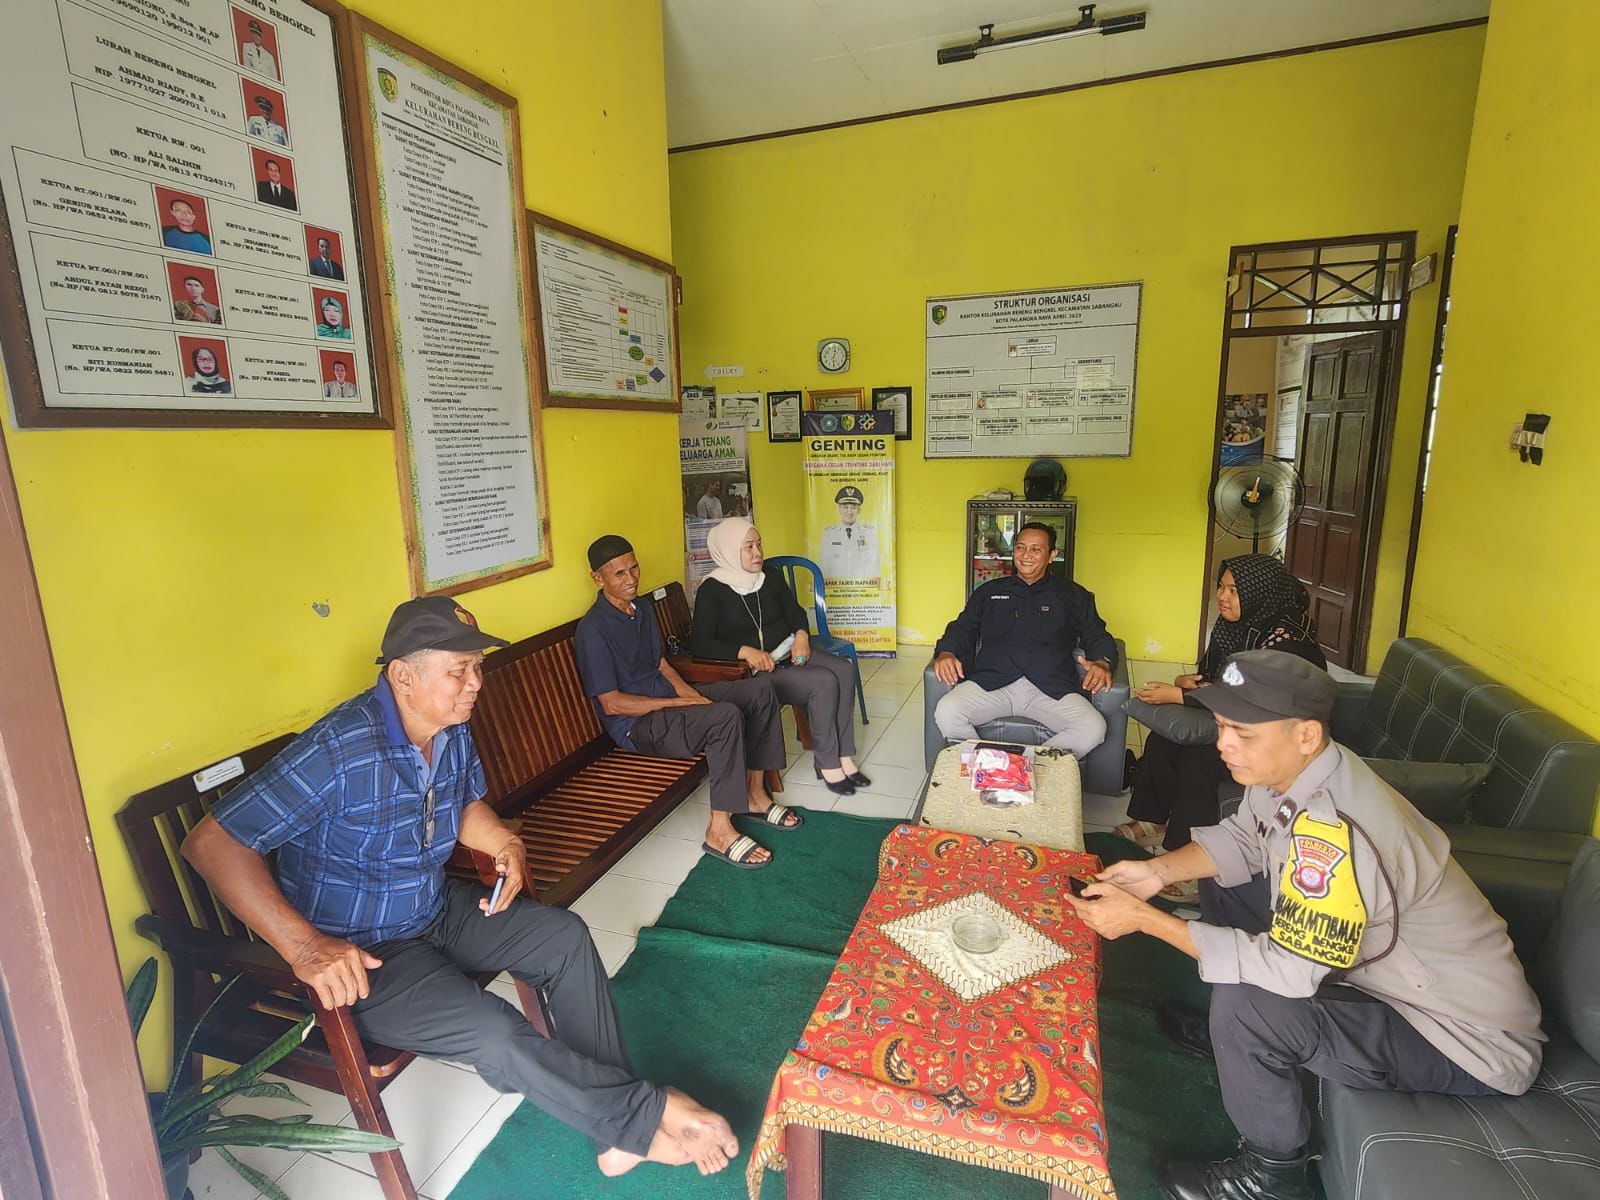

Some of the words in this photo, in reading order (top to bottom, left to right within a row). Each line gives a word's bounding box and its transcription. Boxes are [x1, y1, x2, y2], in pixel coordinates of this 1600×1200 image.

[268, 6, 316, 37] BENGKEL
[95, 35, 132, 56] LURAH
[134, 50, 174, 73] BERENG
[175, 67, 218, 90] BENGKEL
[118, 65, 155, 84] AHMAD
[157, 78, 189, 98] RIADY,
[119, 75, 166, 98] 19771027
[168, 92, 201, 112] 200701
[405, 97, 447, 124] KELURAHAN
[447, 116, 472, 136] BERENG
[473, 131, 500, 150] BENGKEL
[135, 126, 169, 144] KETUA
[171, 138, 189, 150] RW.
[190, 144, 207, 156] 001
[109, 147, 132, 161] (NO.
[133, 155, 168, 171] HP/WA
[148, 149, 164, 161] ALI
[165, 154, 203, 171] SALIHIN
[40, 178, 73, 193] KETUA
[53, 202, 84, 216] HP/WA
[58, 197, 93, 210] GENIUS
[94, 204, 128, 218] KELANA
[225, 221, 247, 232] KETUA
[55, 259, 87, 271] KETUA
[63, 276, 93, 286] ABDUL
[235, 288, 256, 297] KETUA
[994, 297, 1037, 309] STRUKTUR
[1038, 293, 1090, 306] ORGANISASI
[960, 312, 981, 320] KANTOR
[981, 309, 1012, 318] KELURAHAN
[1012, 308, 1032, 316] BERENG
[1033, 306, 1057, 315] BENGKEL
[1058, 304, 1091, 313] KECAMATAN
[1091, 302, 1122, 310] SABANGAU
[1010, 315, 1038, 323] PALANGKA
[1052, 313, 1068, 321] APRIL
[72, 344, 101, 352] KETUA
[83, 365, 112, 374] HP/WA
[702, 435, 732, 448] TENANG
[811, 439, 886, 452] GENTING
[679, 449, 713, 461] ELUARGA
[714, 447, 737, 459] AMAN
[1278, 930, 1351, 966] SABANGAU
